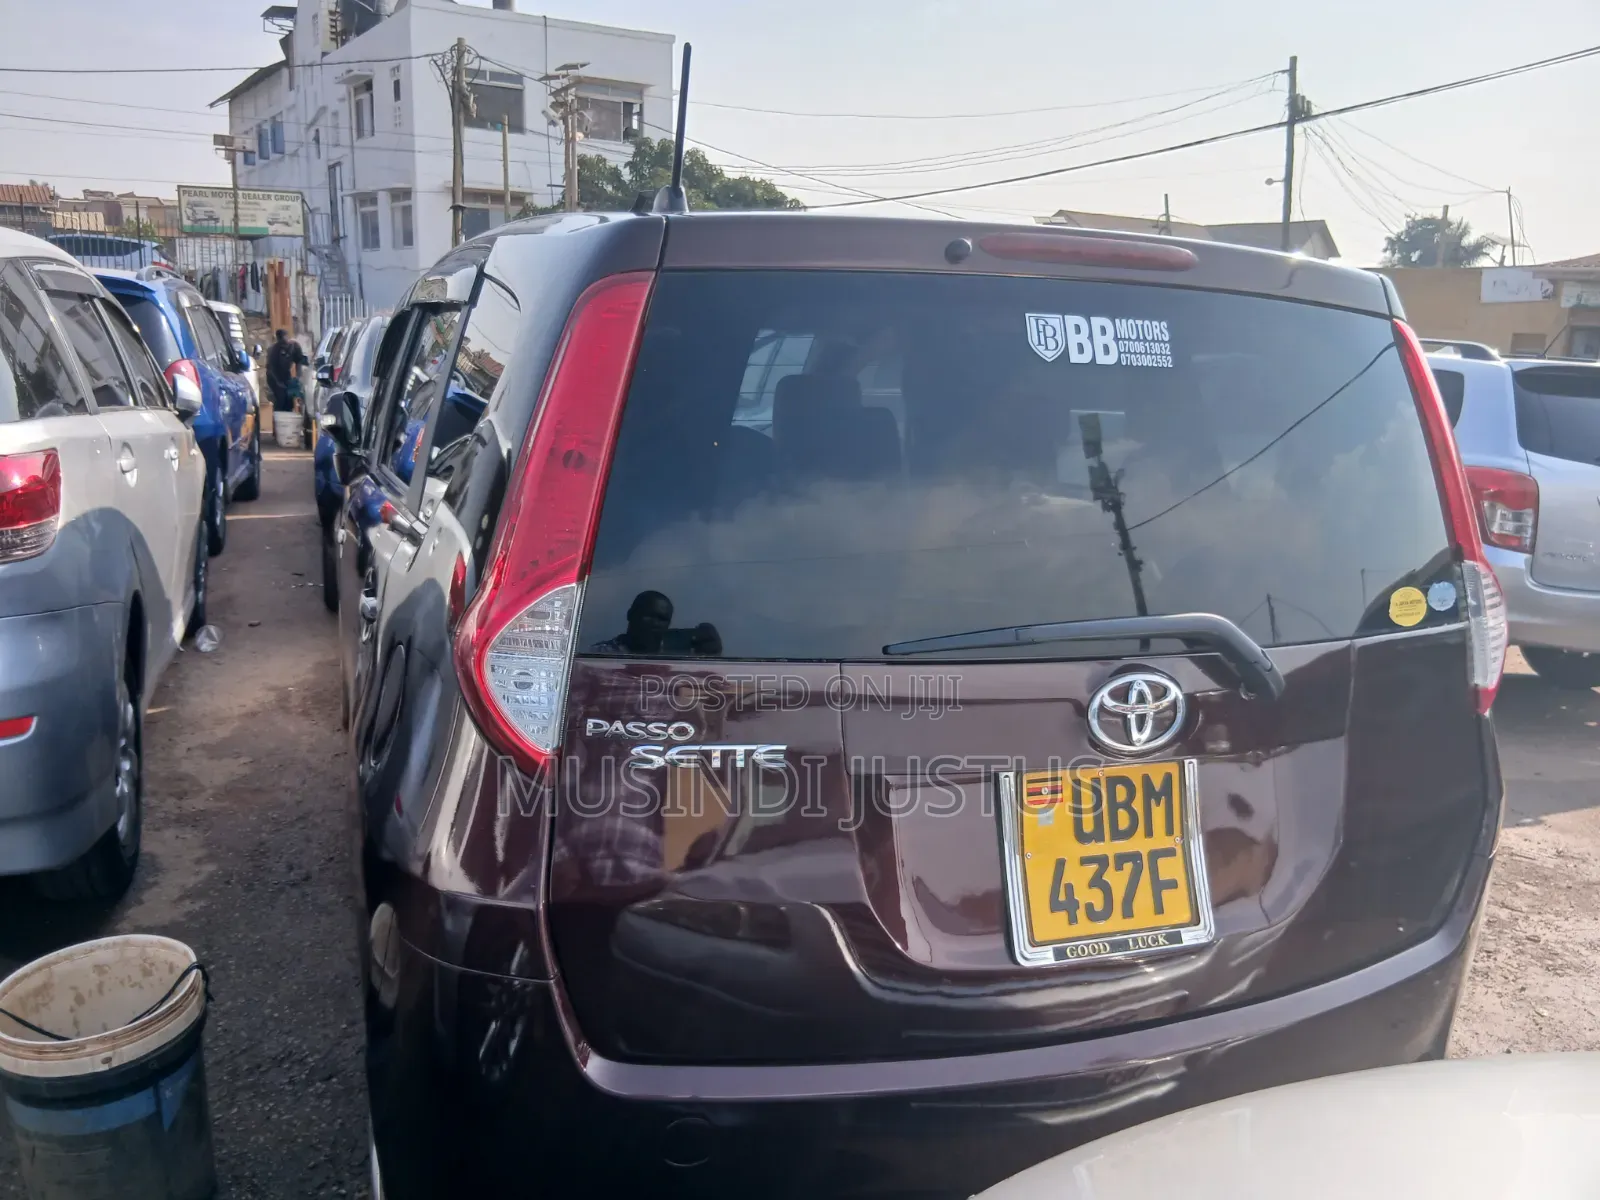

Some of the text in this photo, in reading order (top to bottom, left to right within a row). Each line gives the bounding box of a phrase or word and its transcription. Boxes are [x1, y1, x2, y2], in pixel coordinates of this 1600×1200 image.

[182, 189, 209, 198] PEARL
[242, 192, 273, 201] DEALER
[274, 194, 301, 203] GROUP
[1064, 314, 1170, 365] BB MOTORS
[1118, 340, 1171, 355] 0700613032
[1120, 353, 1173, 368] 0703002552
[585, 718, 695, 741] PASSO
[628, 744, 788, 769] SETTE
[1072, 772, 1174, 845] UBM
[1050, 847, 1179, 926] 437F
[1066, 933, 1170, 958] GOOD LUCK
